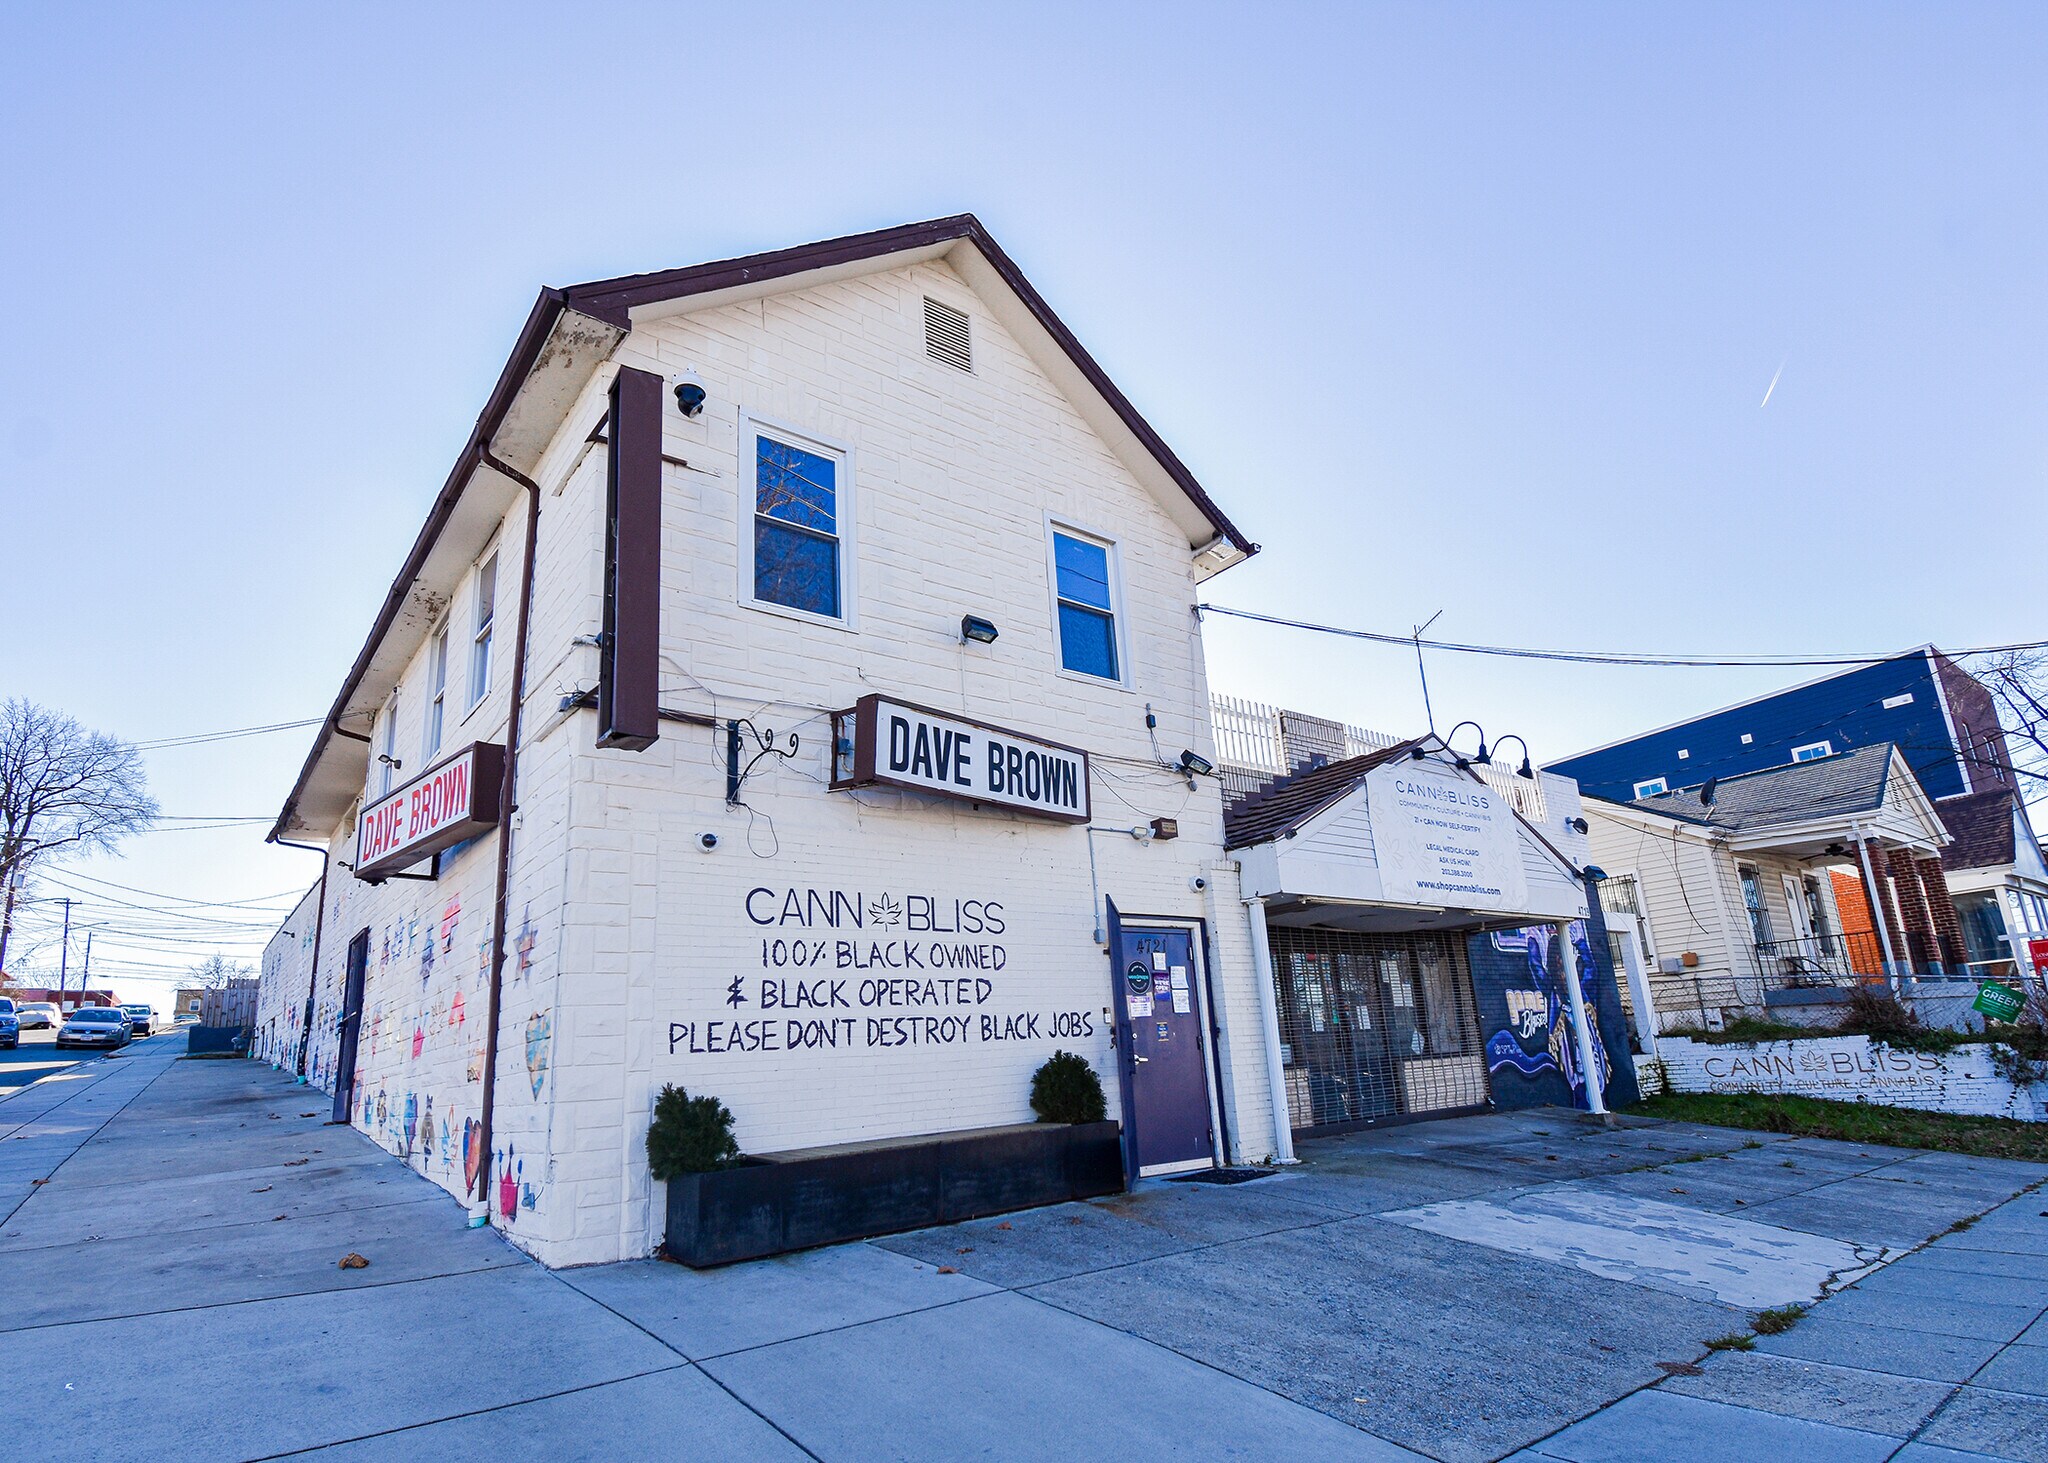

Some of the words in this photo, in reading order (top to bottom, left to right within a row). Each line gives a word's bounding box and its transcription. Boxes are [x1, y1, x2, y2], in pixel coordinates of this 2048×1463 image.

[889, 715, 971, 787] DAVE
[988, 740, 1078, 809] BROWN
[1395, 780, 1437, 799] CANN
[1447, 790, 1490, 809] BLISS
[362, 798, 403, 862] DAVE
[408, 760, 468, 840] BROWN
[1398, 799, 1432, 811] COMMUNITY
[1436, 806, 1461, 816] CULTURE
[1423, 818, 1435, 826] CAN
[1435, 820, 1448, 828] NOW
[1448, 822, 1481, 833] SELF-CERTIFY
[1425, 843, 1442, 852] LEGAL
[1443, 846, 1465, 855] MEDICAL
[1465, 848, 1480, 857] CARD
[1439, 856, 1449, 864] ASK
[1416, 880, 1502, 896] www.shopcannabliss.com
[745, 887, 862, 929] CANN
[907, 895, 1006, 934] BLISS
[762, 939, 826, 968] 100%
[837, 940, 924, 969] BLACK
[930, 943, 1006, 971] OWNED
[1136, 938, 1167, 954] 4721
[726, 975, 749, 1009] &
[760, 979, 850, 1009] BLACK
[859, 978, 992, 1007] OPERATED
[1982, 989, 2020, 1007] GREEN
[669, 1021, 780, 1054] PLEASE
[787, 1018, 857, 1050] DON'T
[867, 1016, 971, 1047] DESTROY
[981, 1012, 1039, 1042] BLACK
[1048, 1011, 1094, 1038] JOBS
[1704, 1055, 1795, 1079] CANN
[1830, 1050, 1943, 1074] BLISS
[1709, 1080, 1784, 1093] COMMUNITY
[1795, 1079, 1852, 1091] CULTURE
[1859, 1076, 1936, 1089] CANNABIS
